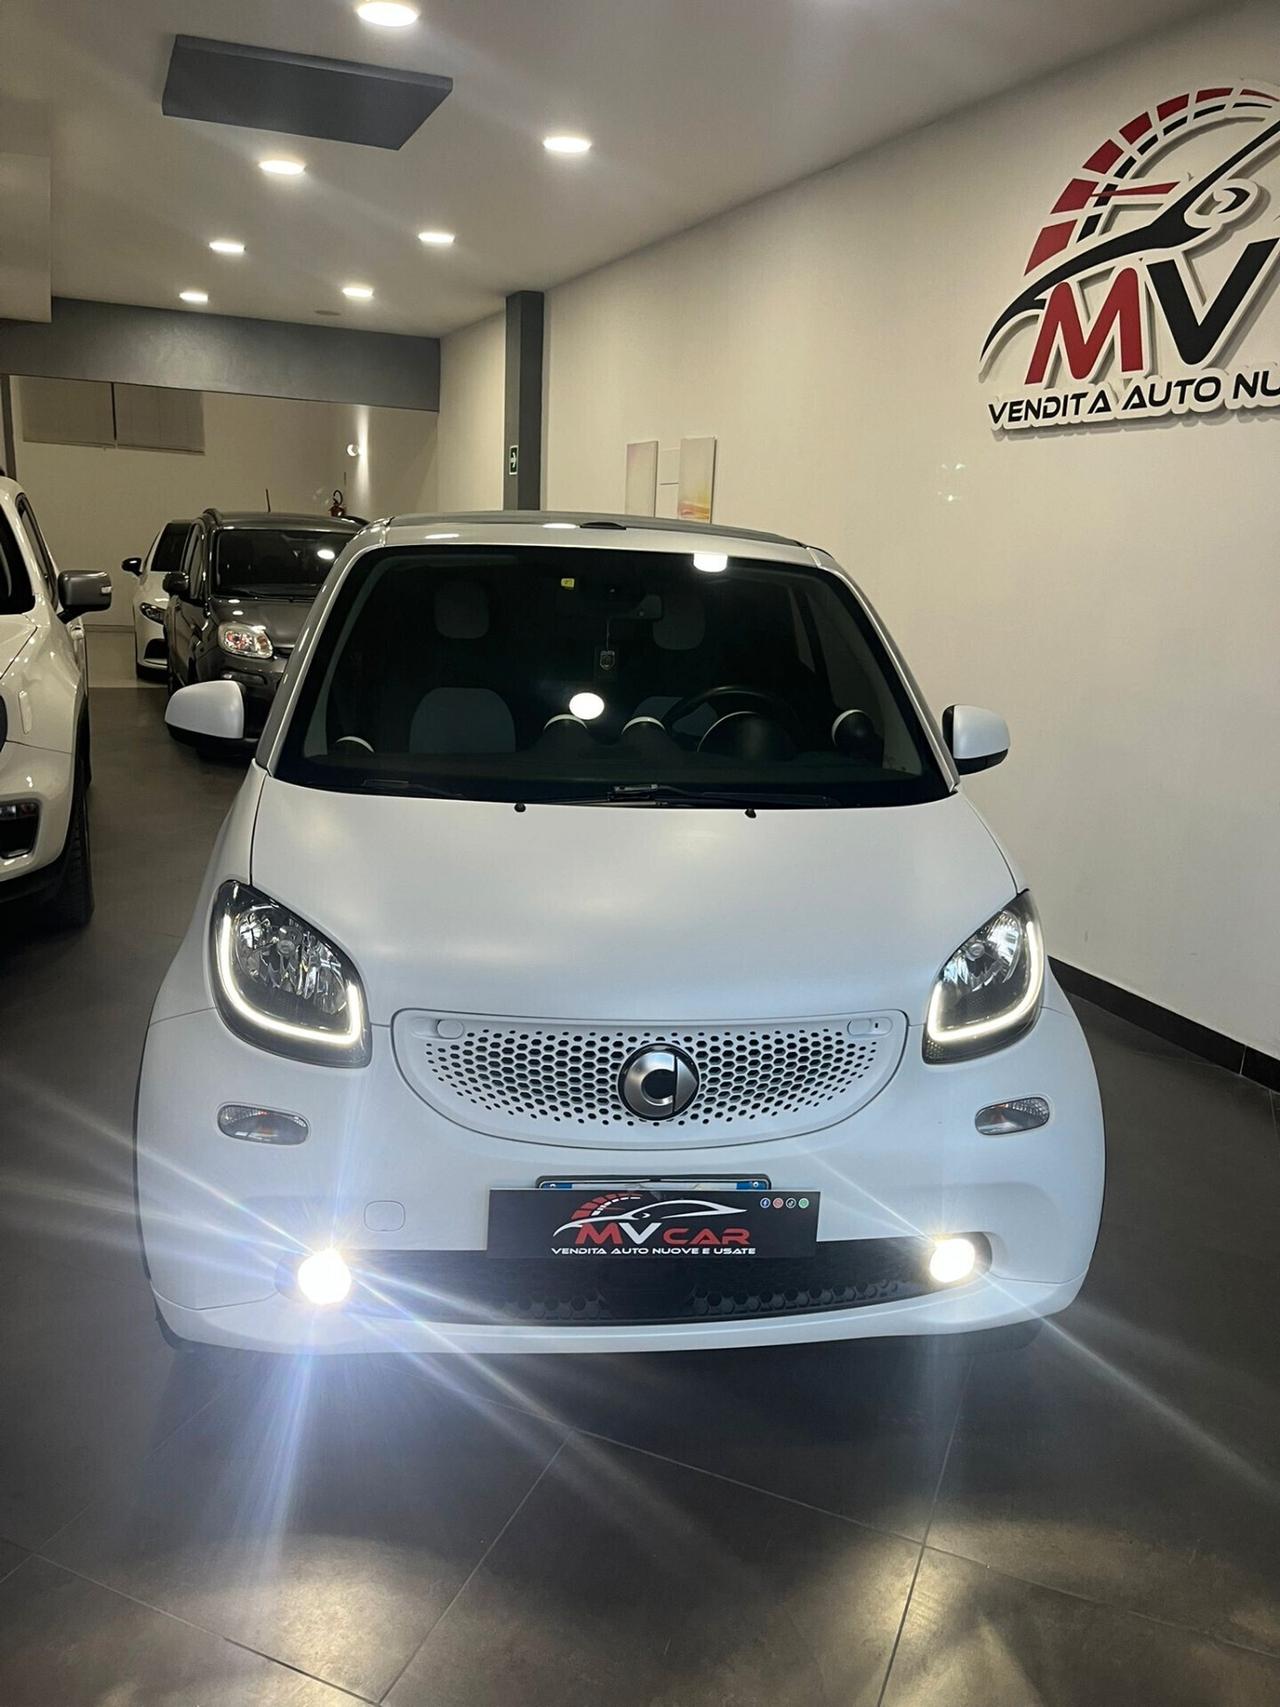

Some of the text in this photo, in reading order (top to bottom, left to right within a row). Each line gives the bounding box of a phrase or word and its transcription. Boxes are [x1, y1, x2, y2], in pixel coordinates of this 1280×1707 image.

[1025, 237, 1280, 385] MV
[988, 389, 1112, 424] VENDITA
[1121, 376, 1222, 411] AUTO
[551, 1247, 756, 1255] VENDITA AUTO NUOVE E USATE
